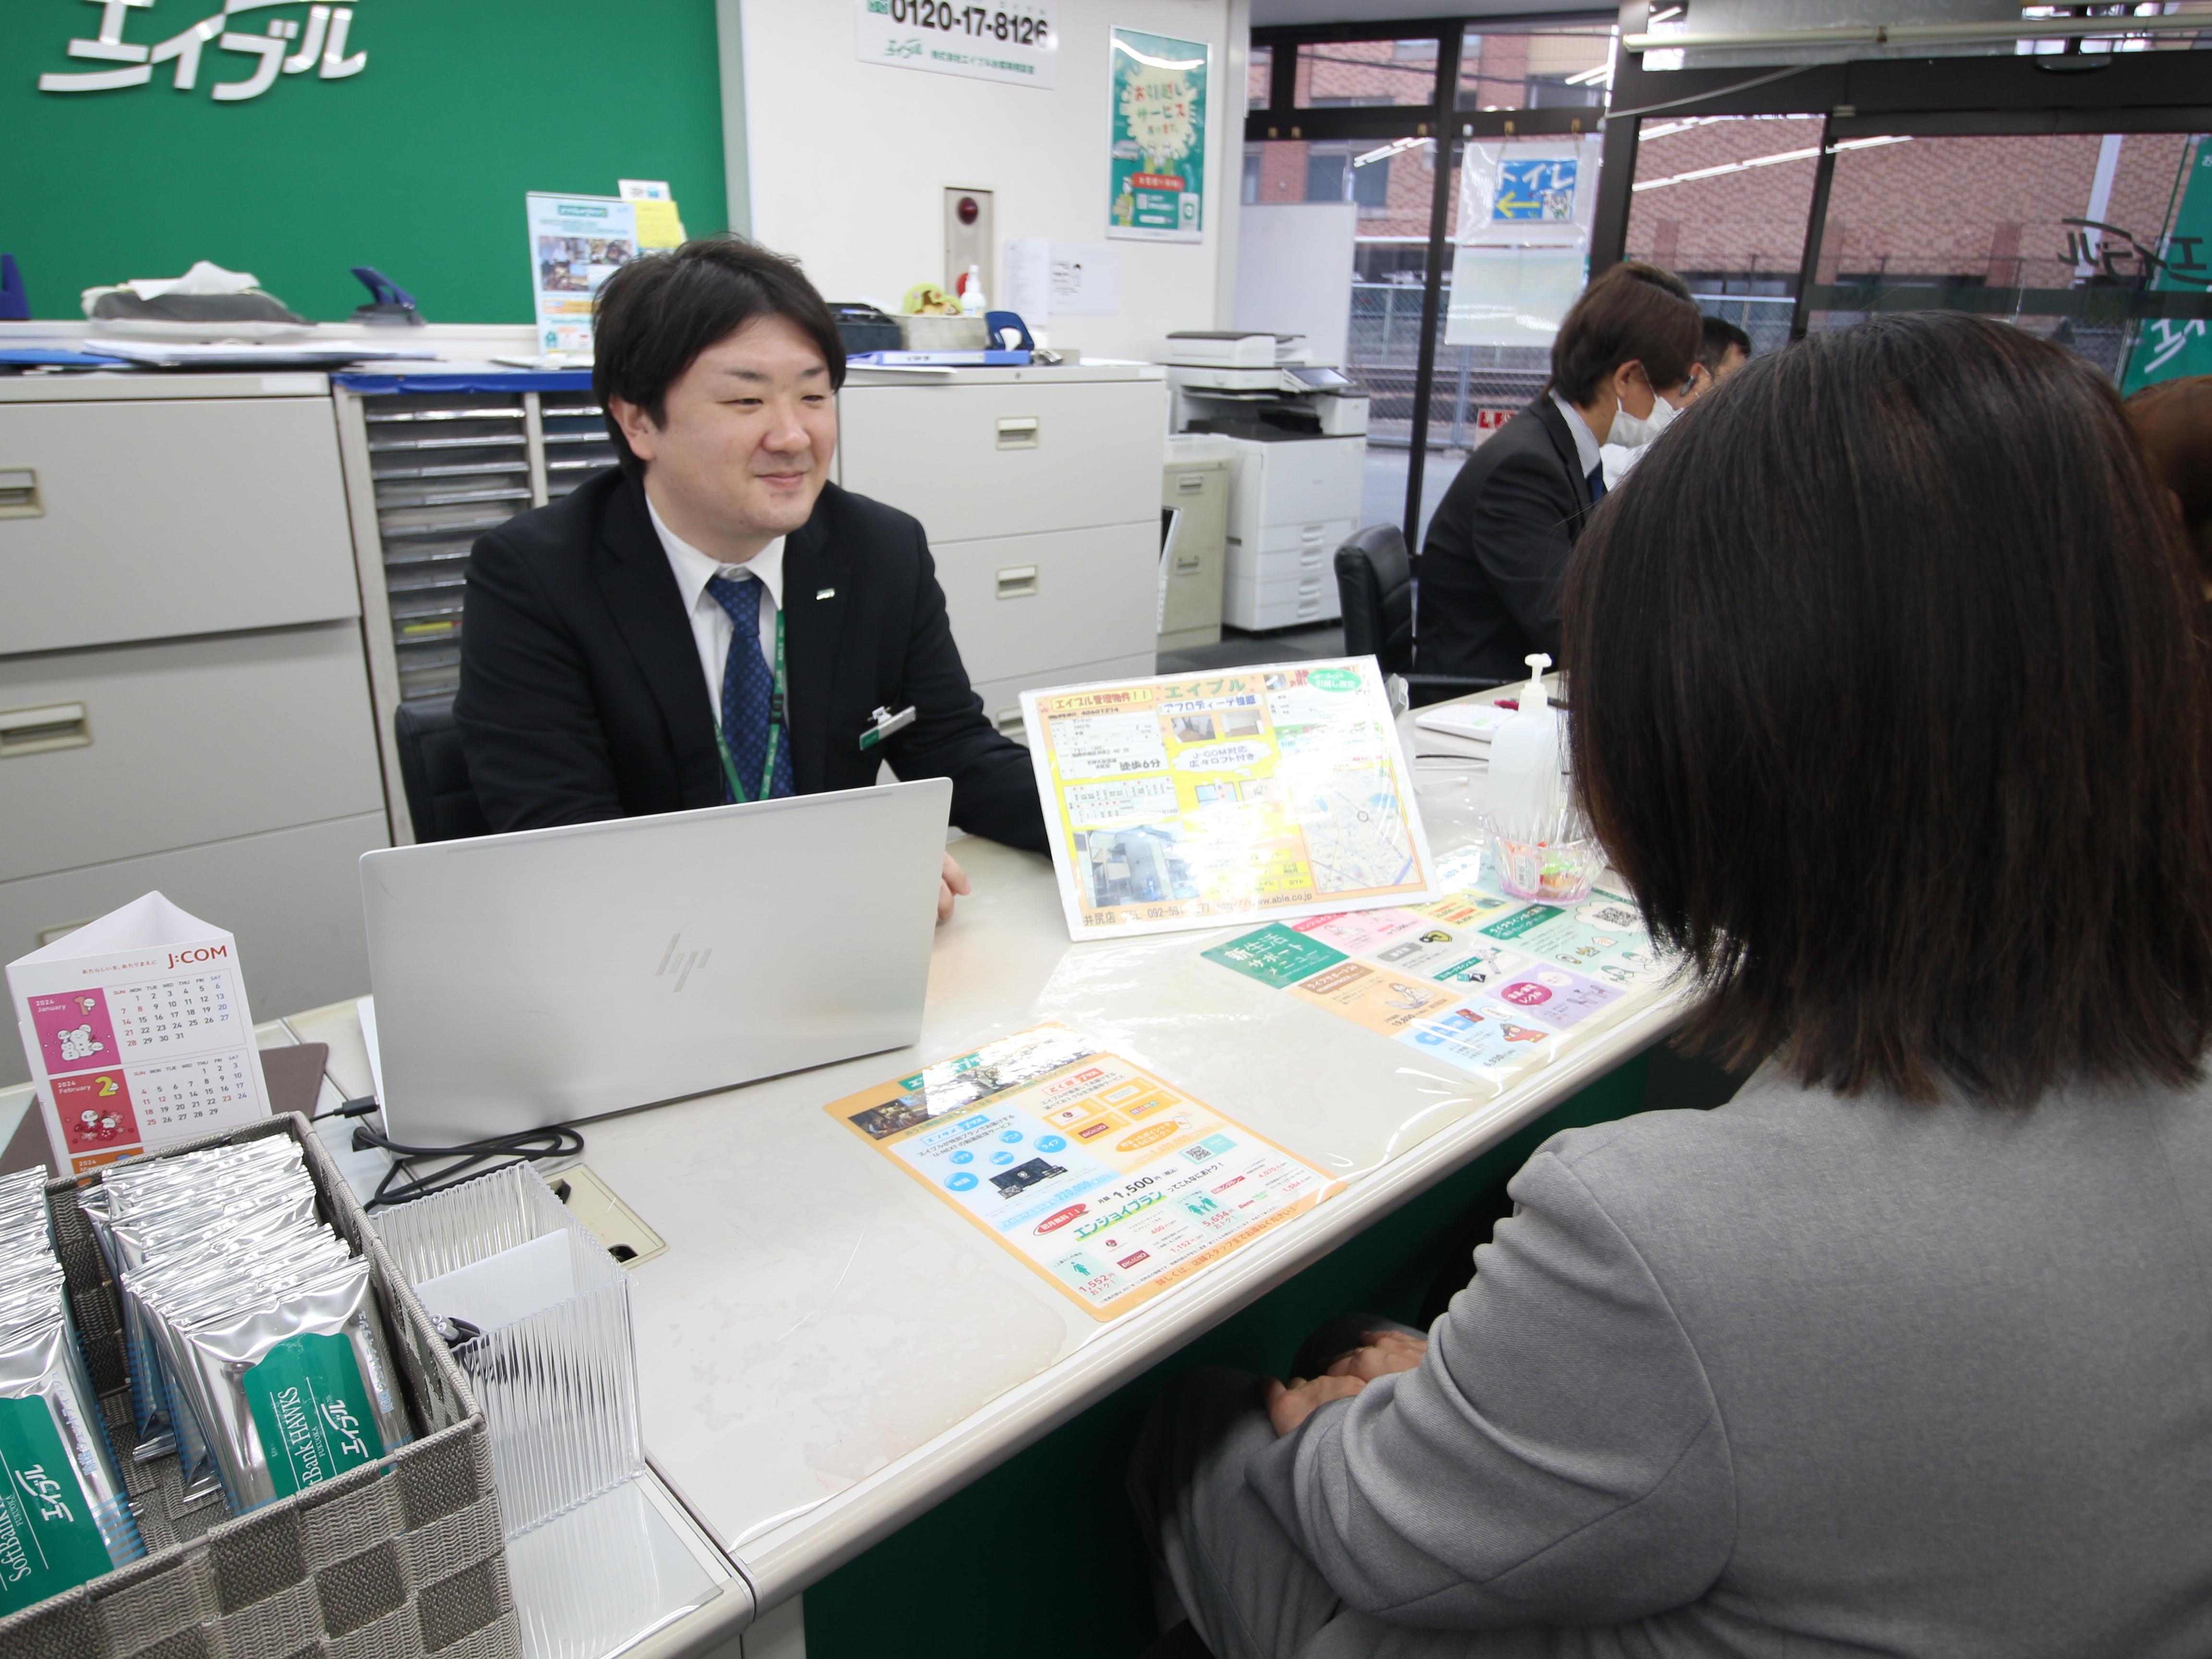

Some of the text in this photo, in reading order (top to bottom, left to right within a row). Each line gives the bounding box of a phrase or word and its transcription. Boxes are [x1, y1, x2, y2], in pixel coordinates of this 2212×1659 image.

[892, 0, 1048, 48] 0120-17-8126
[38, 0, 368, 101] エイブル
[1497, 163, 1574, 190] トイレ
[1164, 679, 1246, 698] エイブル
[1119, 758, 1161, 771] 徒歩6分
[1189, 753, 1254, 768] 広々ロフト付き
[1083, 912, 1116, 926] 井尻店
[168, 945, 228, 969] J:COM
[1221, 932, 1290, 962] 新生活
[1244, 941, 1308, 970] サポート
[1263, 948, 1322, 975] メニュー
[37, 1004, 66, 1012] January
[73, 996, 89, 1016] 1
[58, 1084, 91, 1094] February
[95, 1076, 117, 1096] 2
[1001, 1131, 1021, 1142] アニメ
[951, 1153, 972, 1162] ドラマ
[1071, 1189, 1166, 1238] エンジョイプラン
[1165, 1162, 1226, 1193] ってこんなにおトク！
[278, 1386, 311, 1445] HAWKS
[320, 1399, 369, 1458] エイブル
[312, 1426, 325, 1457] FUKUOKA
[15, 1464, 74, 1522] エイブル
[6, 1494, 22, 1527] FUKUOKA
